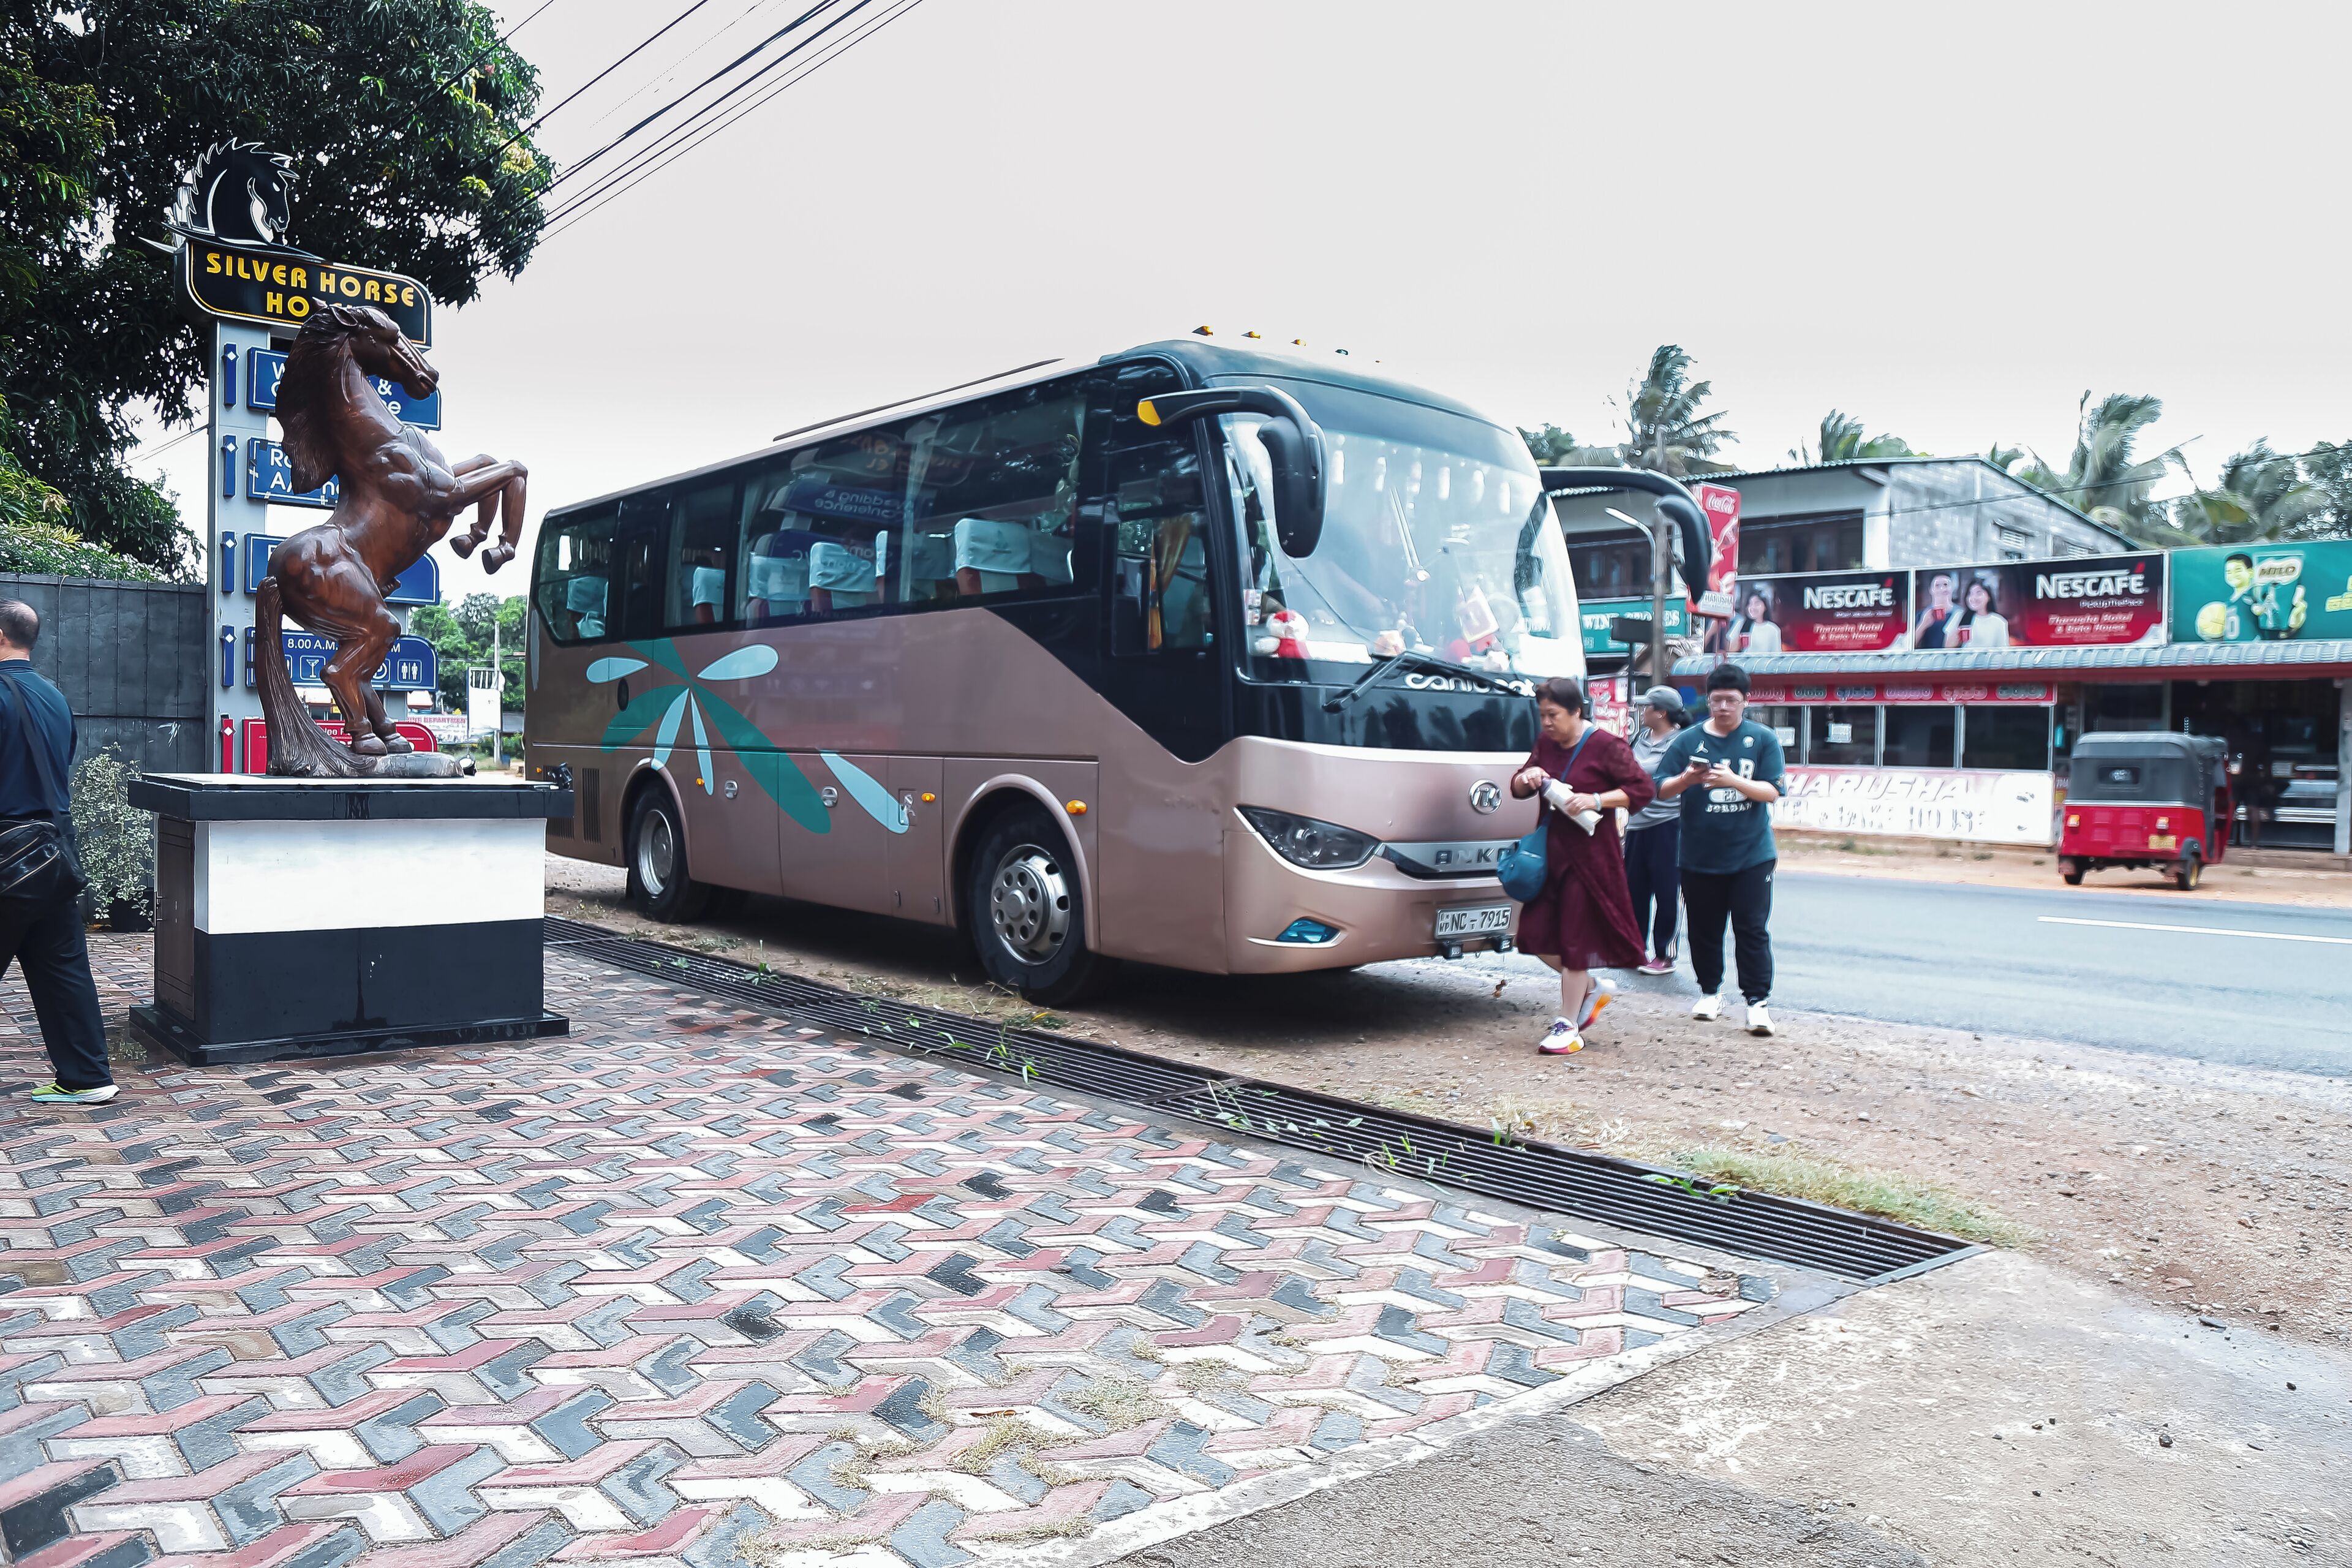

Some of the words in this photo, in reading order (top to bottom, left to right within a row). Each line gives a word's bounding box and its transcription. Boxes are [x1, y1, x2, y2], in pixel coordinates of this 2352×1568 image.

[206, 252, 307, 289] SILVER
[320, 271, 415, 307] HORSE
[377, 375, 393, 396] &
[287, 638, 311, 650] 8.00
[314, 641, 338, 650] A.M.
